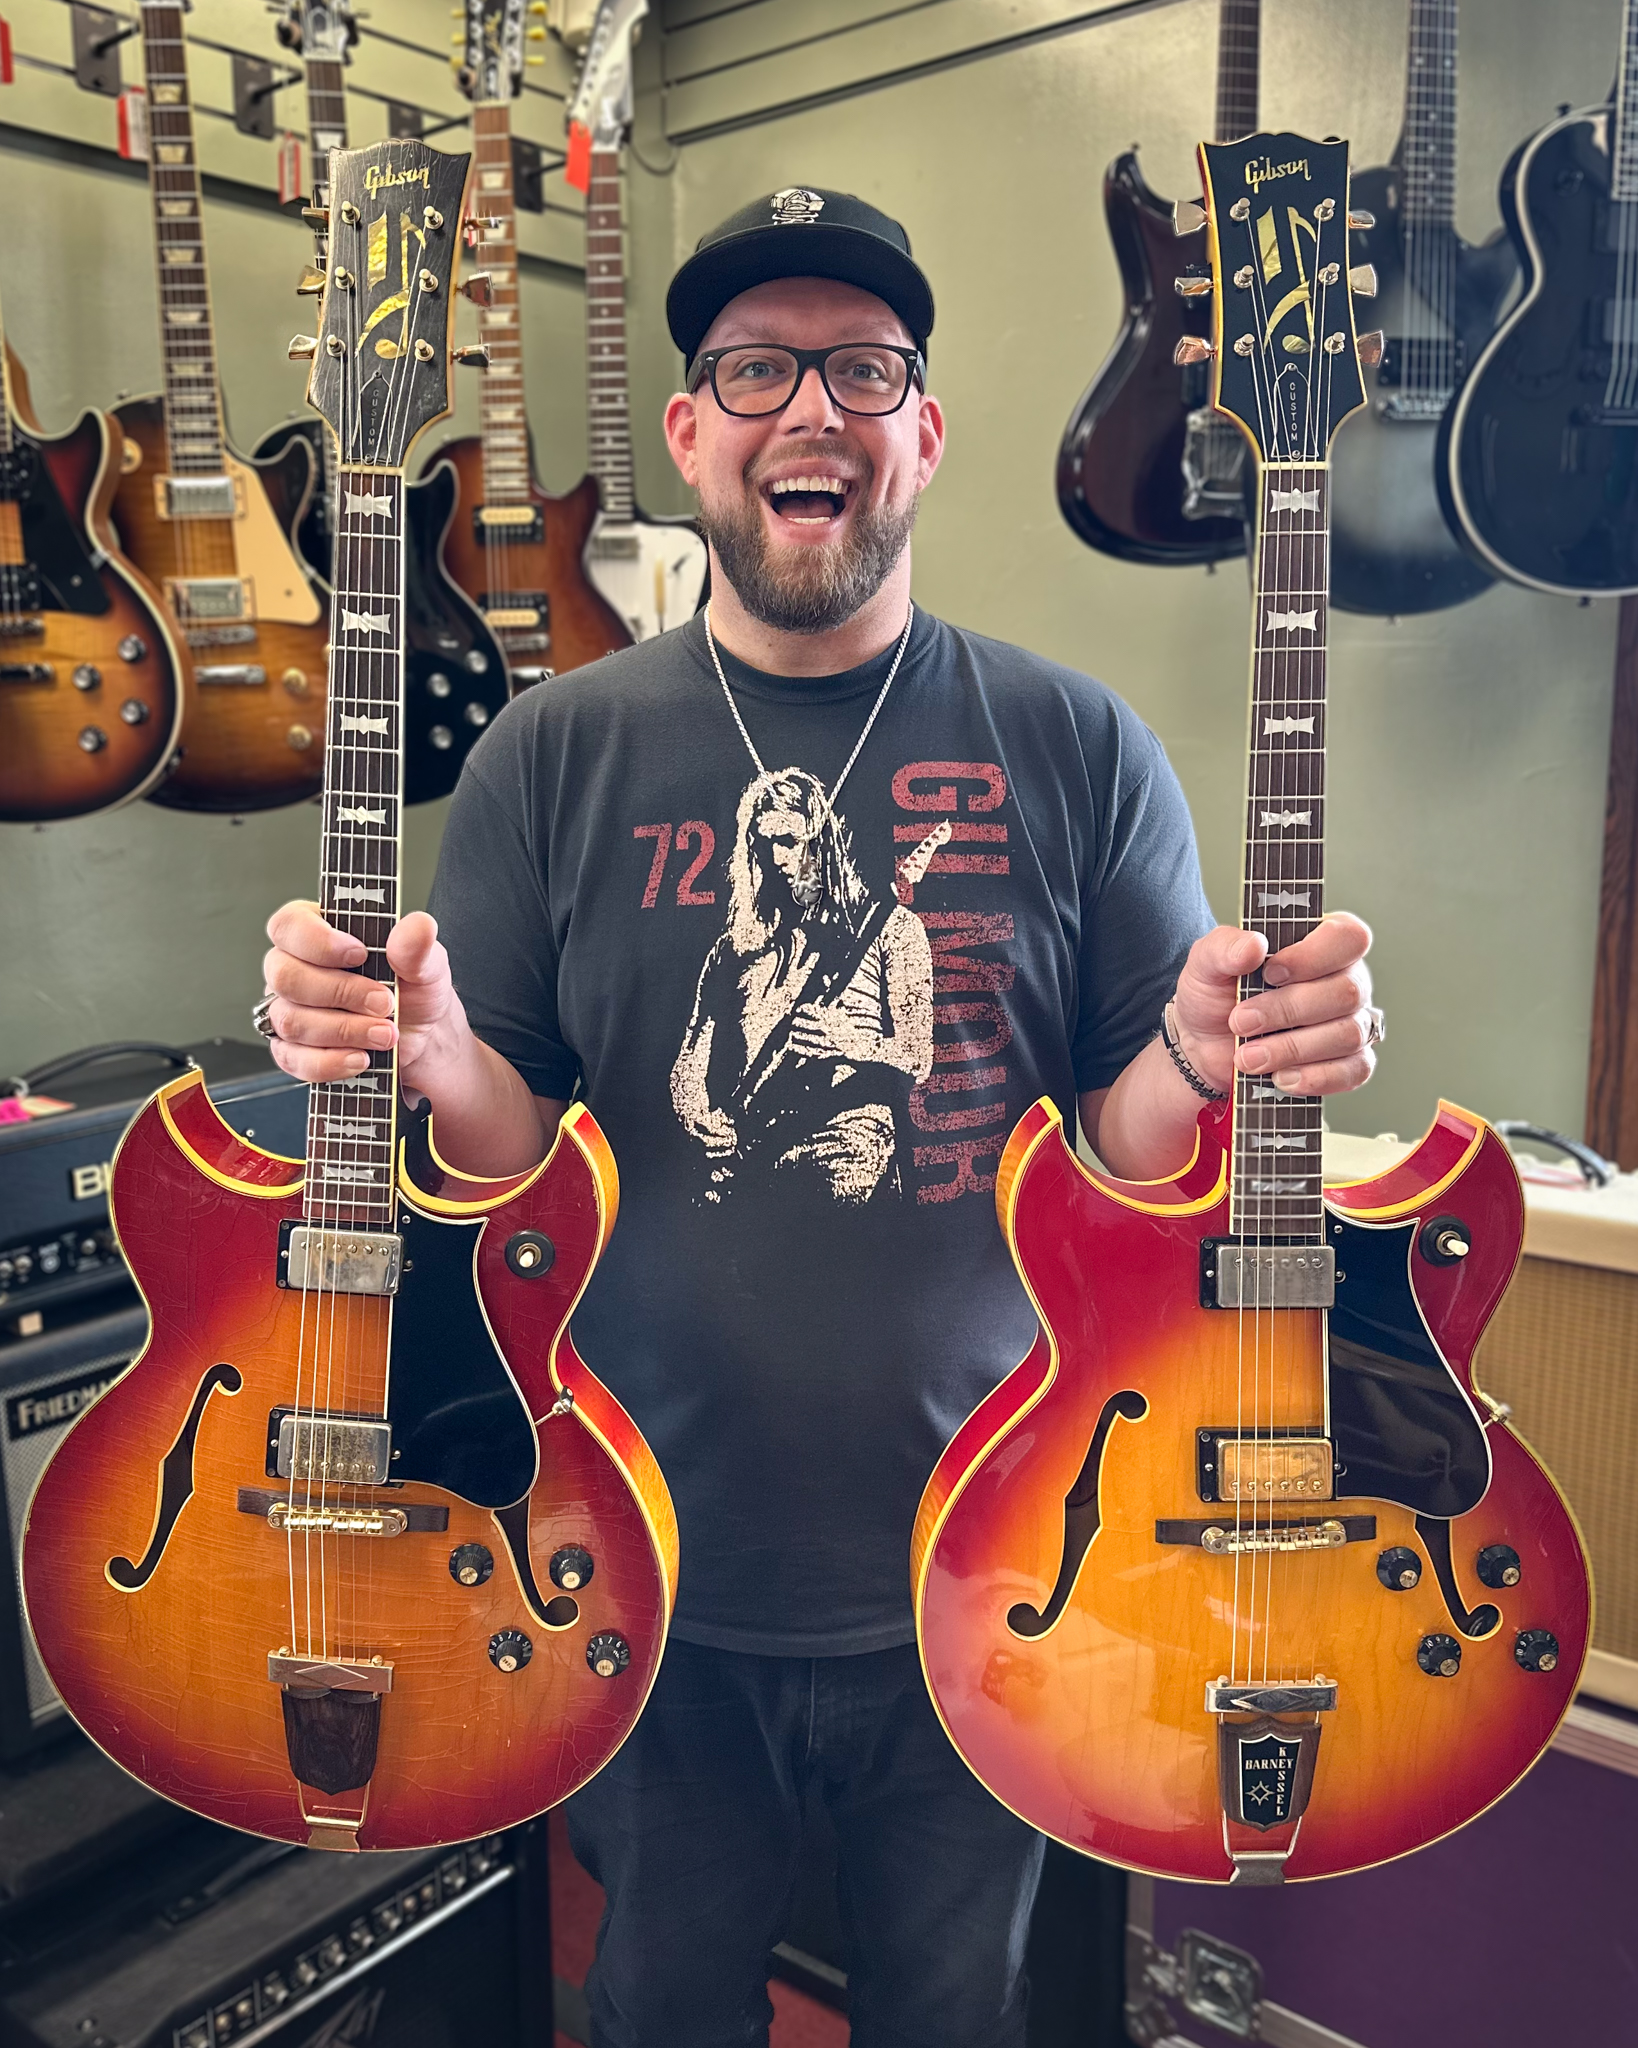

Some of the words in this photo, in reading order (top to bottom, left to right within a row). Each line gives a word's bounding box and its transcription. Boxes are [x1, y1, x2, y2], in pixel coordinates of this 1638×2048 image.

[364, 162, 431, 200] Gibson
[1245, 156, 1312, 194] Gibson
[368, 389, 380, 446] CUSTOM
[1289, 382, 1298, 441] CUSTOM
[633, 820, 716, 909] 72
[891, 760, 1016, 1205] GILMOUR
[1245, 1758, 1294, 1770] BARNEY
[1276, 1746, 1288, 1817] KESSEL
